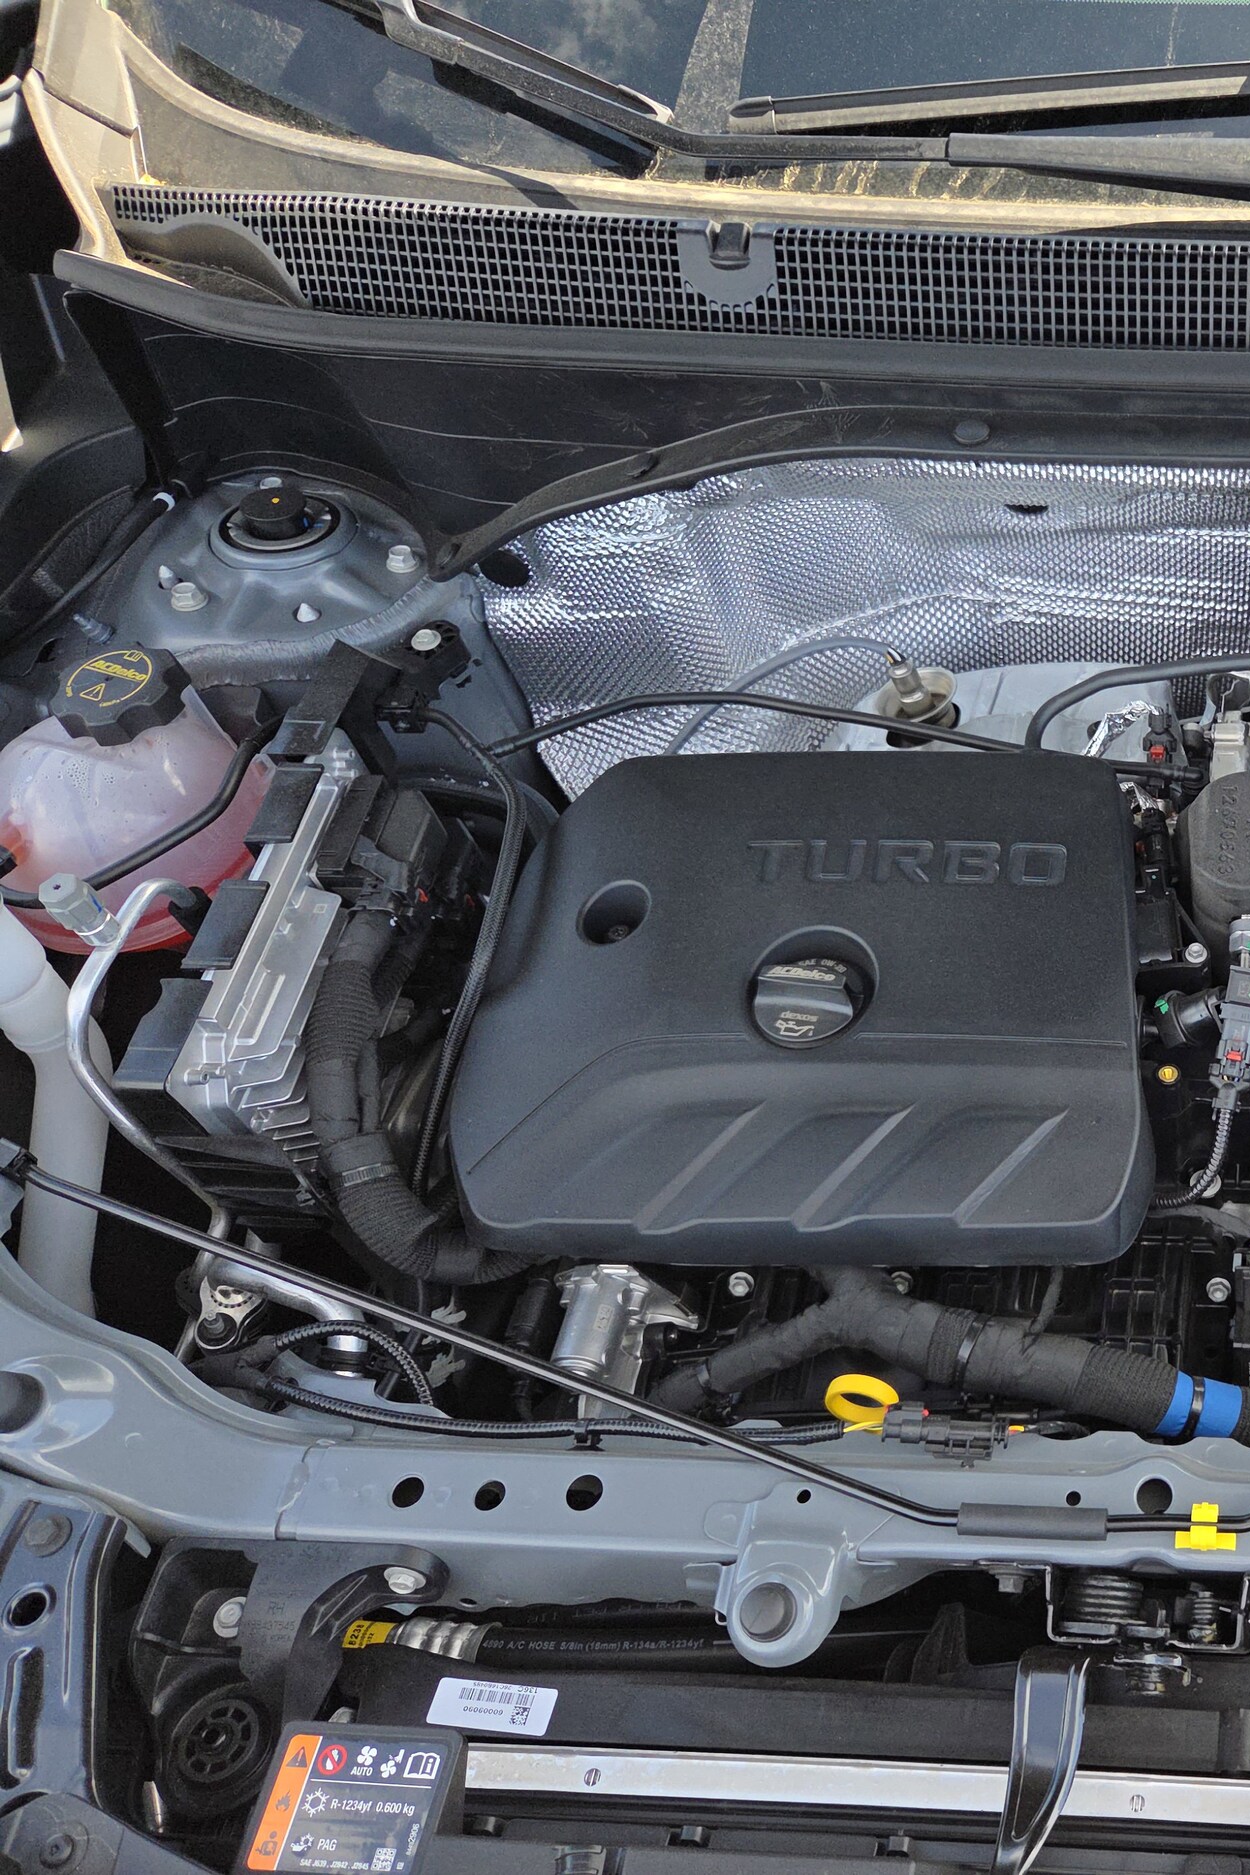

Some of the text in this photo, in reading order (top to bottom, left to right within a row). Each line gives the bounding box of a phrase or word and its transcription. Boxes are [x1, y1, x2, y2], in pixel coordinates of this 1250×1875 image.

[89, 660, 148, 681] ACDelco
[747, 839, 1068, 886] TURBO
[821, 958, 848, 974] 0W-20
[768, 965, 836, 982] ACDelco
[779, 1010, 820, 1022] dexos
[507, 1640, 526, 1650] A/C
[528, 1641, 556, 1651] HOSE
[462, 1704, 504, 1716] 60009090
[350, 1766, 374, 1777] AUTO
[330, 1800, 416, 1817] R-1234yf 0.600 kg
[316, 1838, 338, 1851] PAG
